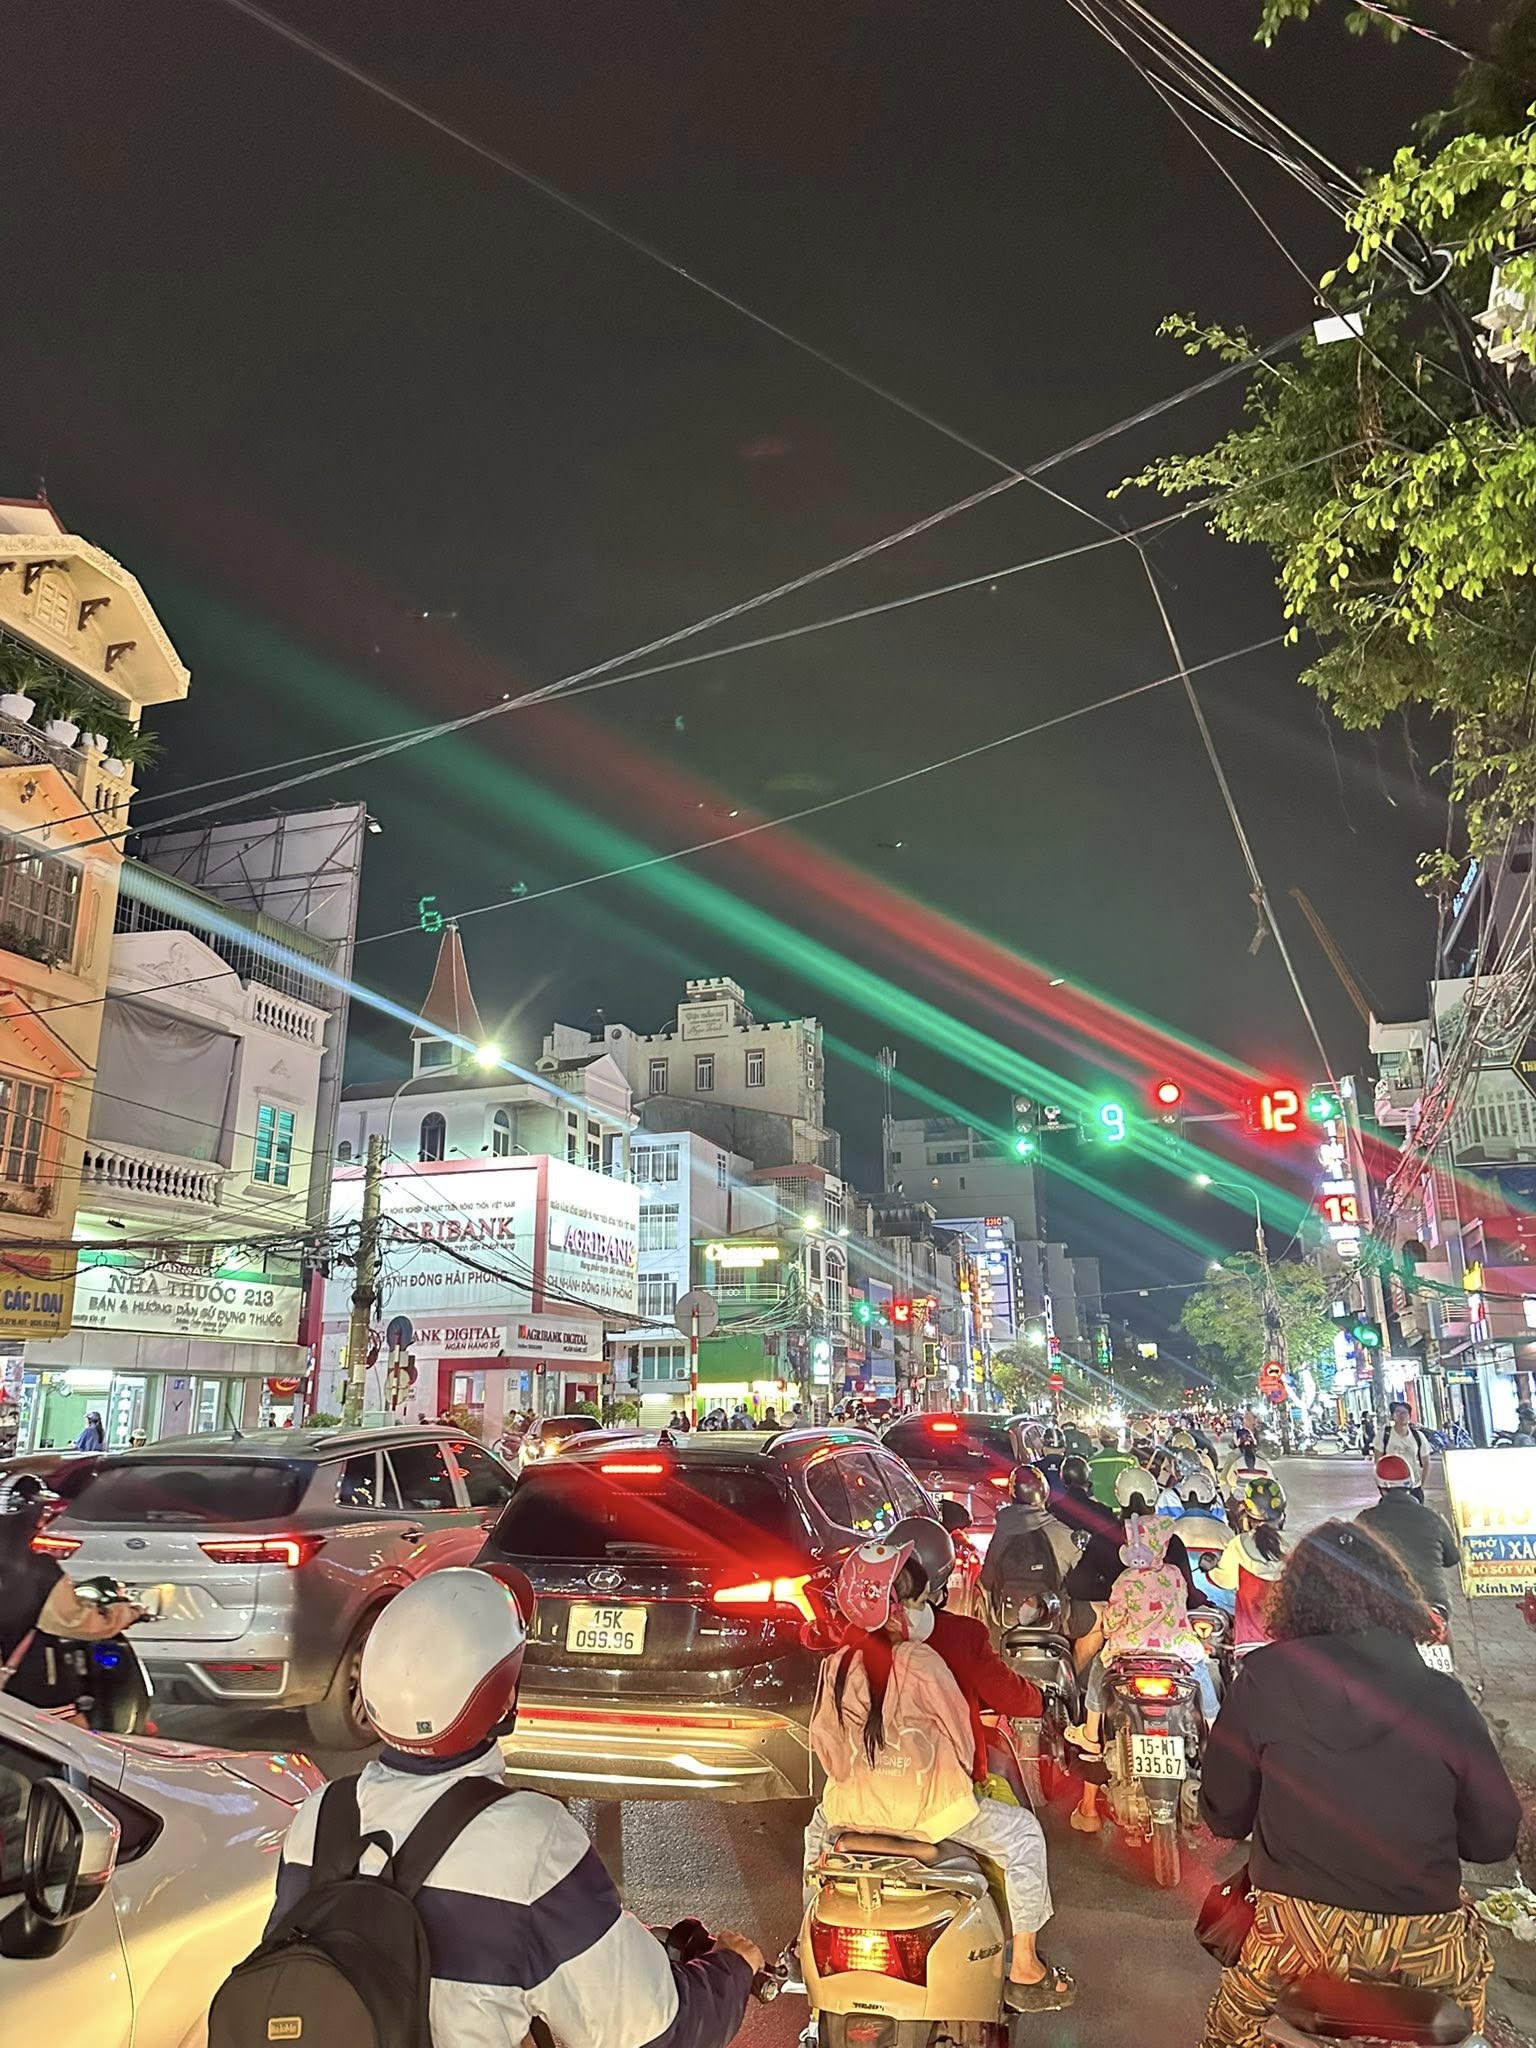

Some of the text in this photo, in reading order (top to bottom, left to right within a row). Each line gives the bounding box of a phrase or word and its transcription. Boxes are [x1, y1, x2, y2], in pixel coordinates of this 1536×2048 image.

[1261, 1090, 1298, 1132] 12
[1101, 1103, 1125, 1141] 9
[1325, 1197, 1357, 1222] 13
[391, 1217, 515, 1242] AGRIBANK
[564, 1225, 634, 1265] AGRIBANK
[410, 1272, 441, 1286] ĐÔNG
[446, 1270, 465, 1285] HẢI
[582, 1278, 600, 1295] ĐÔNG
[108, 1273, 274, 1308] NHÀ THUỐC 213
[3, 1285, 64, 1317] CÁC LOẠI
[88, 1295, 116, 1312] BÁN
[444, 1326, 501, 1341] DIGITAL
[526, 1329, 588, 1346] AGRIBANK DIGITAL
[1490, 1563, 1513, 1575] SỐT
[1475, 1583, 1508, 1594] Kính
[594, 1610, 624, 1629] 15K
[576, 1629, 634, 1650] 099.96
[1140, 1738, 1175, 1756] 15-N1
[1135, 1756, 1181, 1775] 335.67
